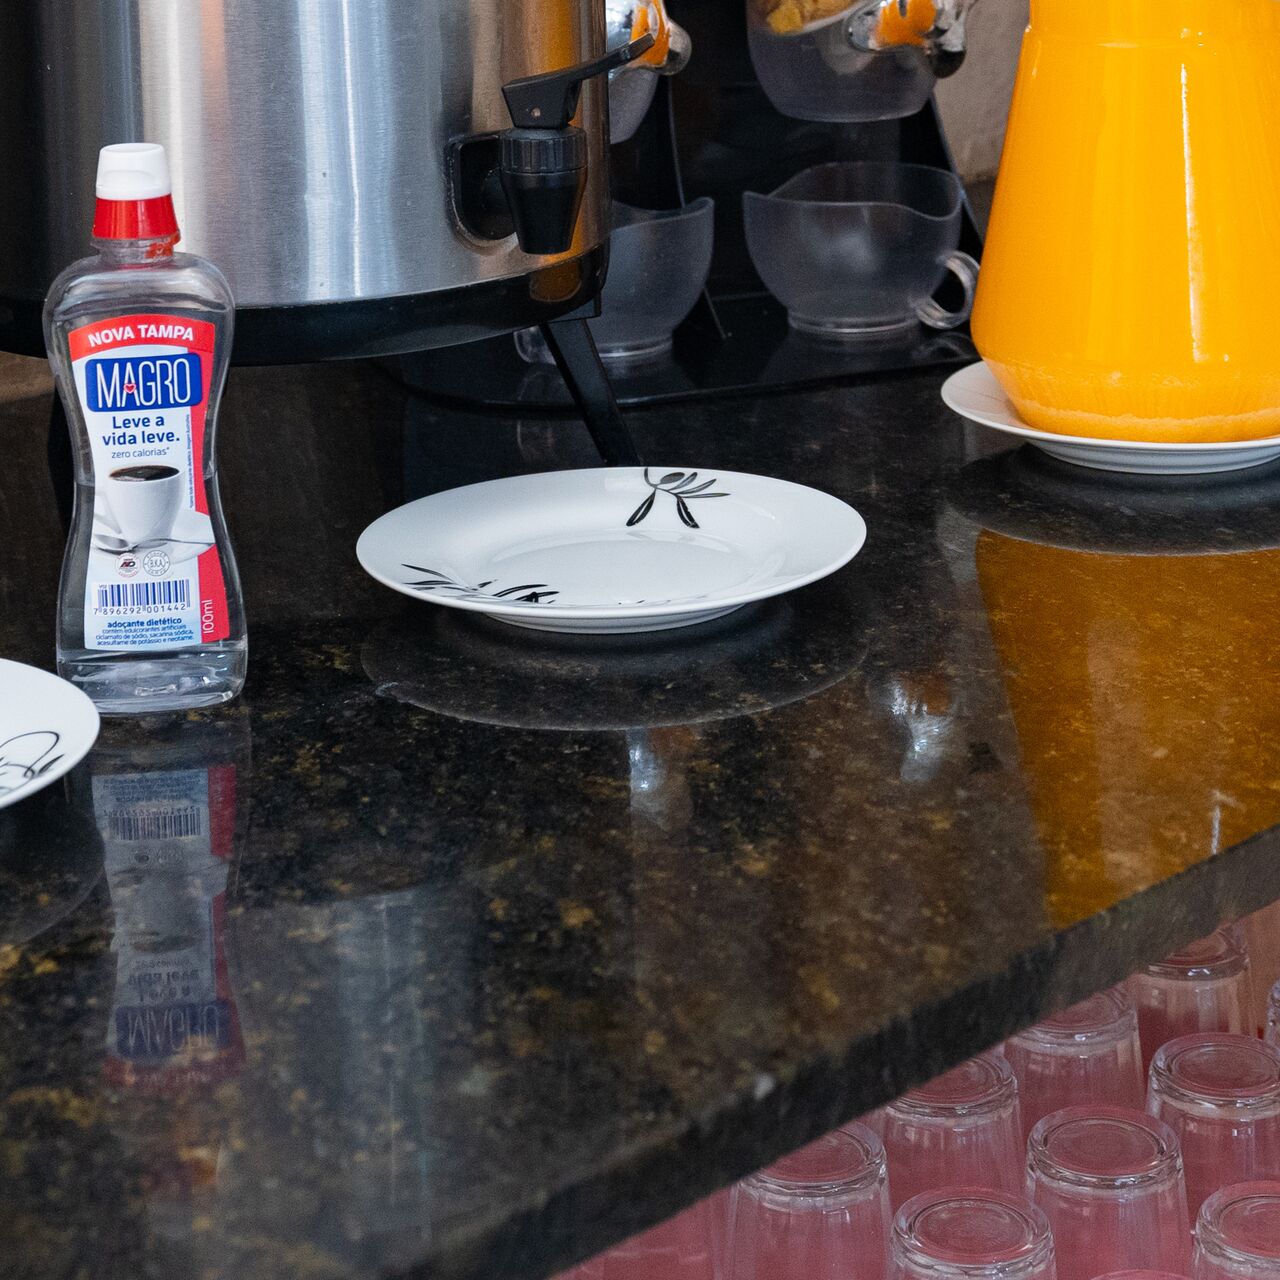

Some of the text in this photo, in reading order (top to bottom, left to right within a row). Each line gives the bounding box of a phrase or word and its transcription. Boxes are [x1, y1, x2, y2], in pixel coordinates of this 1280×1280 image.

[87, 324, 194, 347] NOVA TAMPA
[95, 358, 192, 409] MAGRO
[112, 416, 165, 429] Leve a
[102, 431, 181, 446] vida leve.
[111, 451, 131, 459] zero
[103, 606, 141, 615] 896292
[146, 604, 186, 614] 001442
[201, 599, 215, 634] 100ml
[107, 617, 182, 629] adoçante dietético
